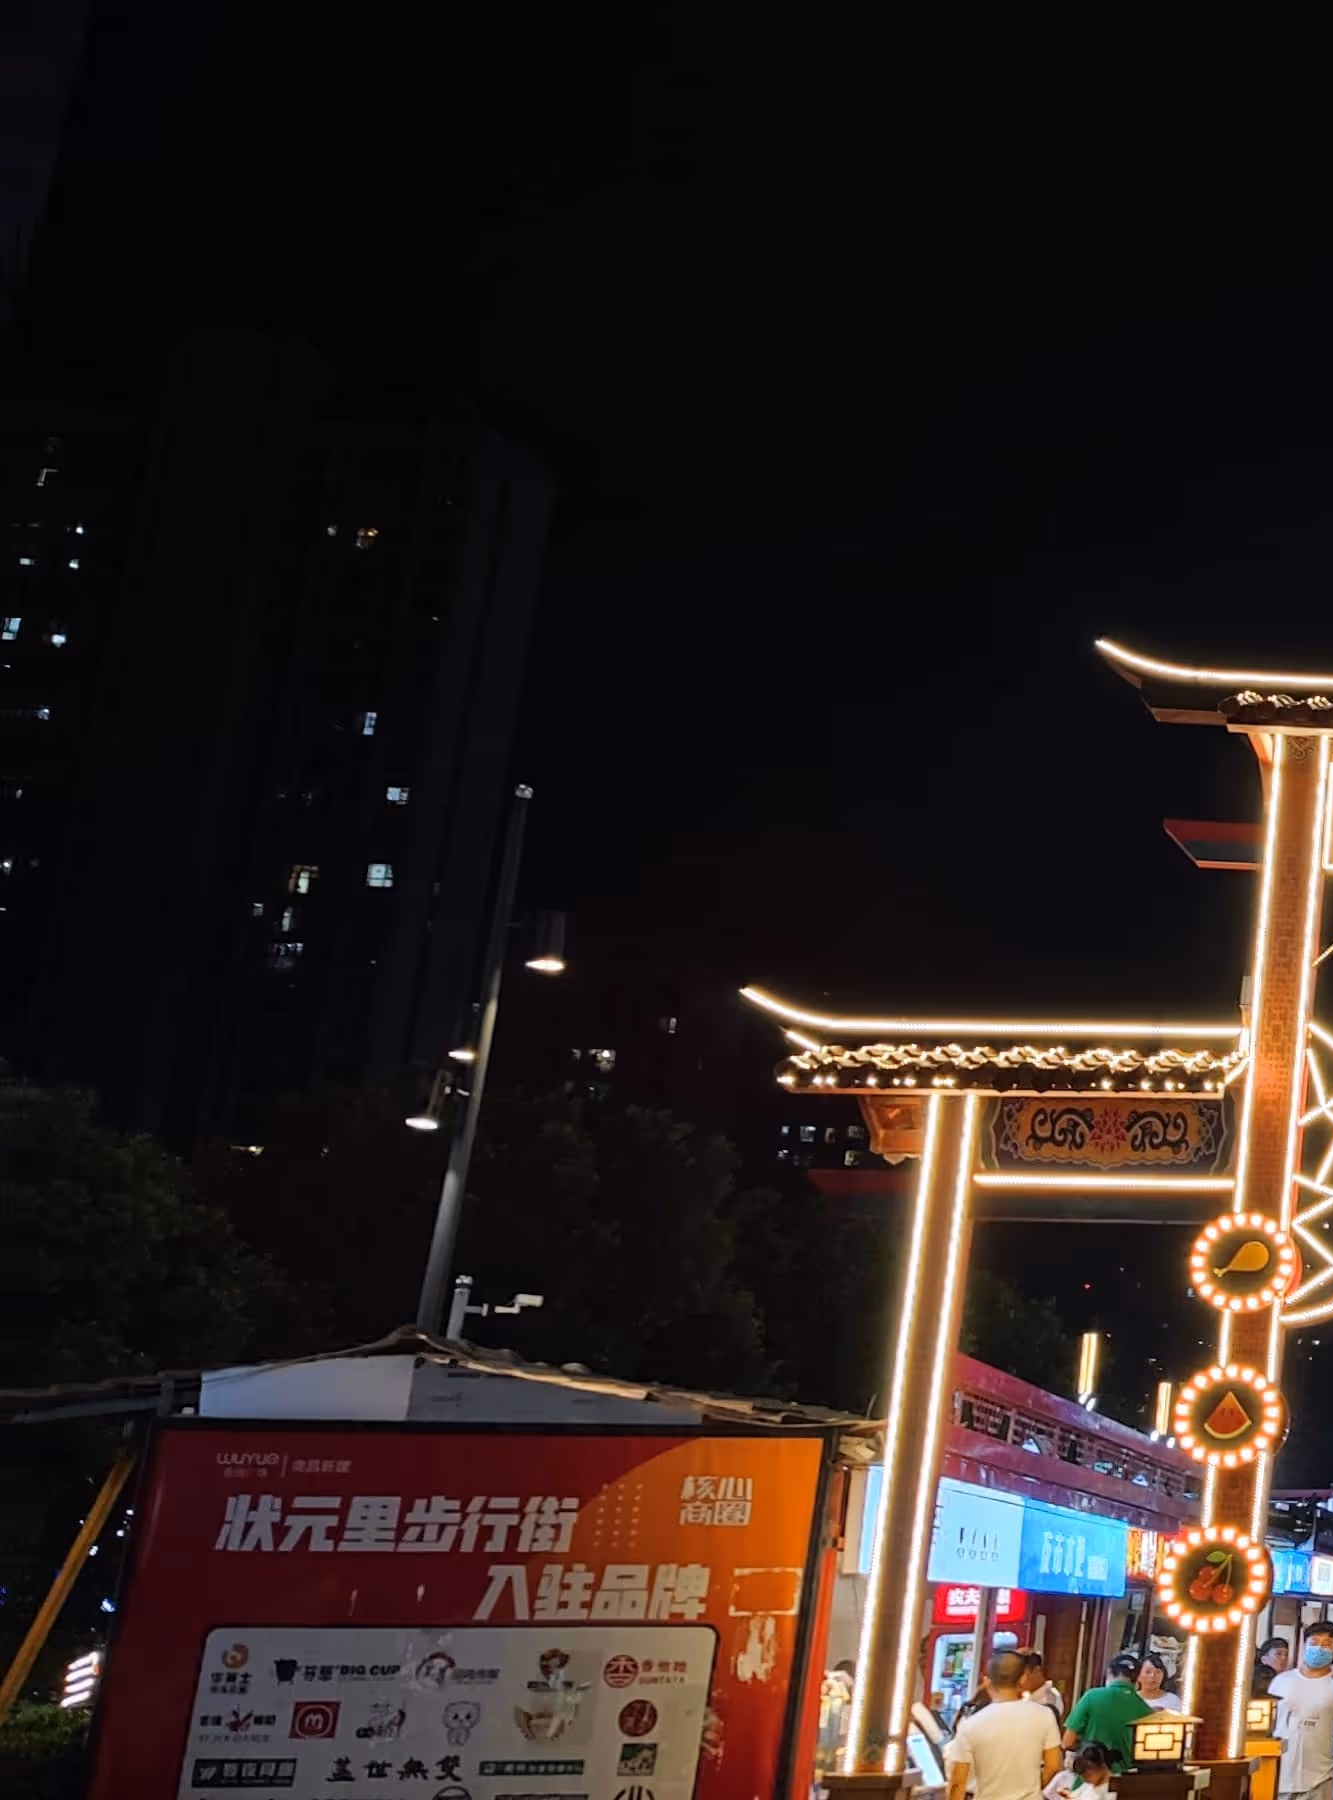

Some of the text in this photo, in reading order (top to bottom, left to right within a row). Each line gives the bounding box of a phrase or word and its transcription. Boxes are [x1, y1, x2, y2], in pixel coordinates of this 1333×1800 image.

[681, 1475, 753, 1500] 核心
[214, 1494, 580, 1553] 状元里步行街
[679, 1501, 752, 1526] 商圈
[472, 1563, 711, 1621] 入驻品牌
